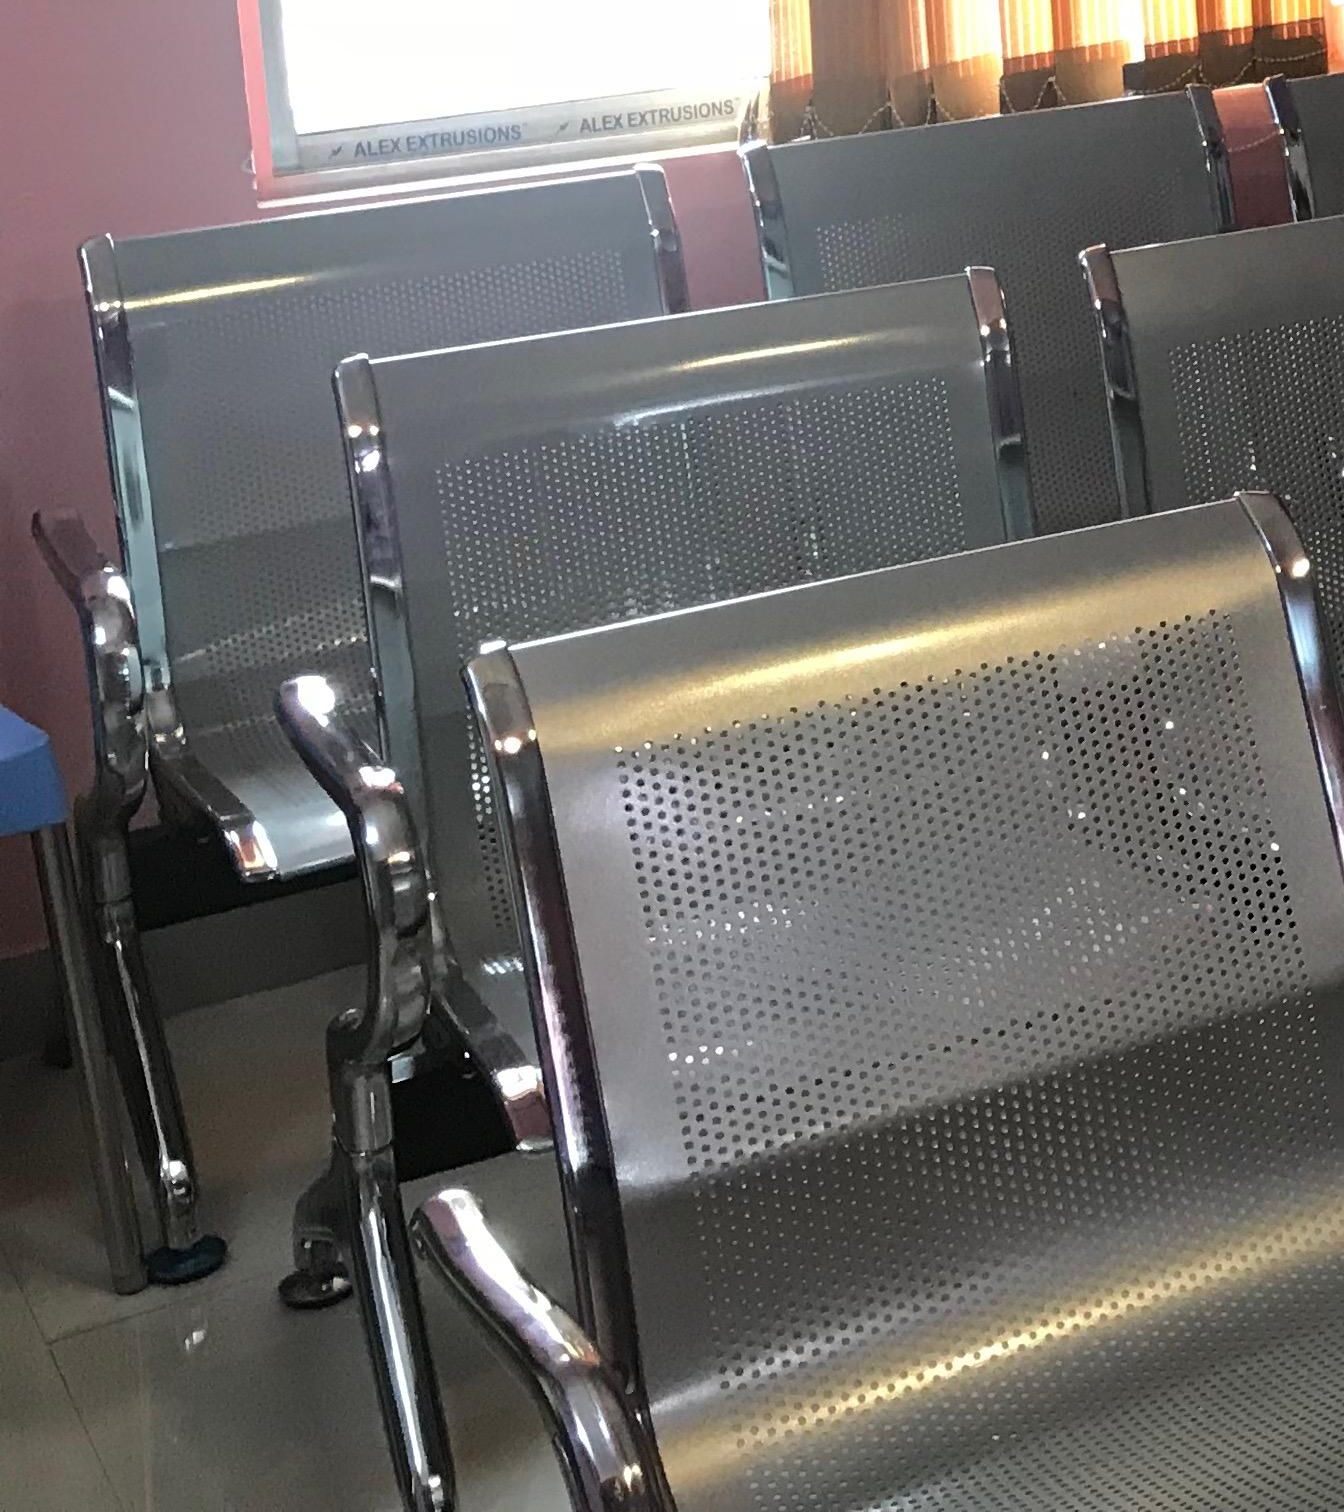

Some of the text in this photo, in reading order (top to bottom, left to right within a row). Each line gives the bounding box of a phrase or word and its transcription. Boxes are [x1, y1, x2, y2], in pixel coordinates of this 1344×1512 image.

[579, 99, 734, 133] ALEX EXTRUSIONS
[354, 125, 522, 157] ALEX EXTRUSIONS
